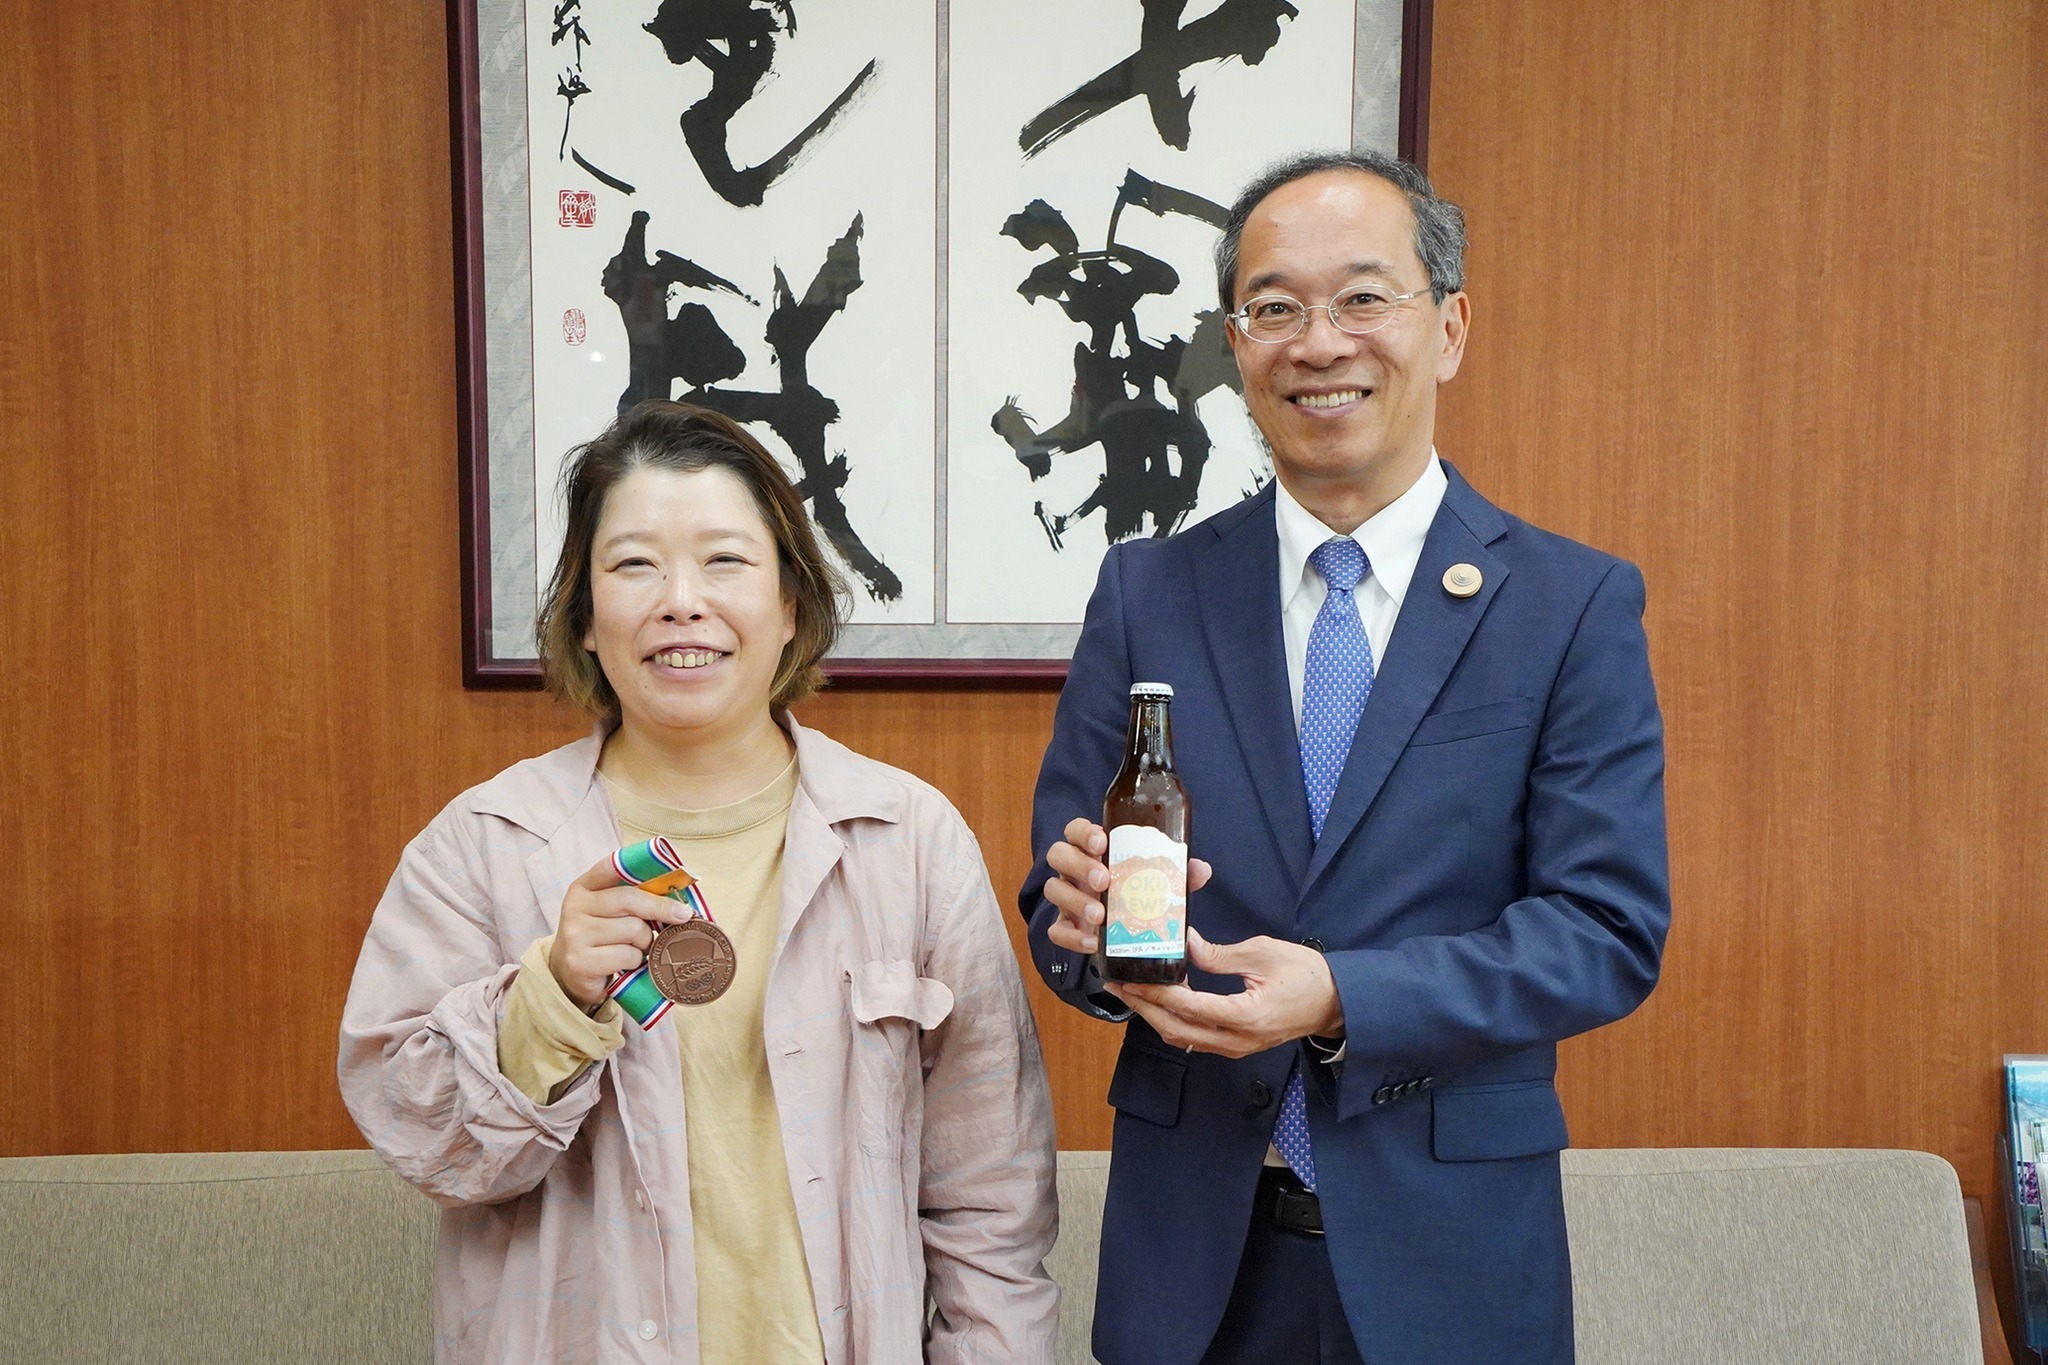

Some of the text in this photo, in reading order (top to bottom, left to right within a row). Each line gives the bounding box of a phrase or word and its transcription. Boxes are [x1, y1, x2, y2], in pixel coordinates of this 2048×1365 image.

[1129, 875, 1166, 891] OKU
[652, 921, 731, 960] INTERNATIONAL BEER CUP
